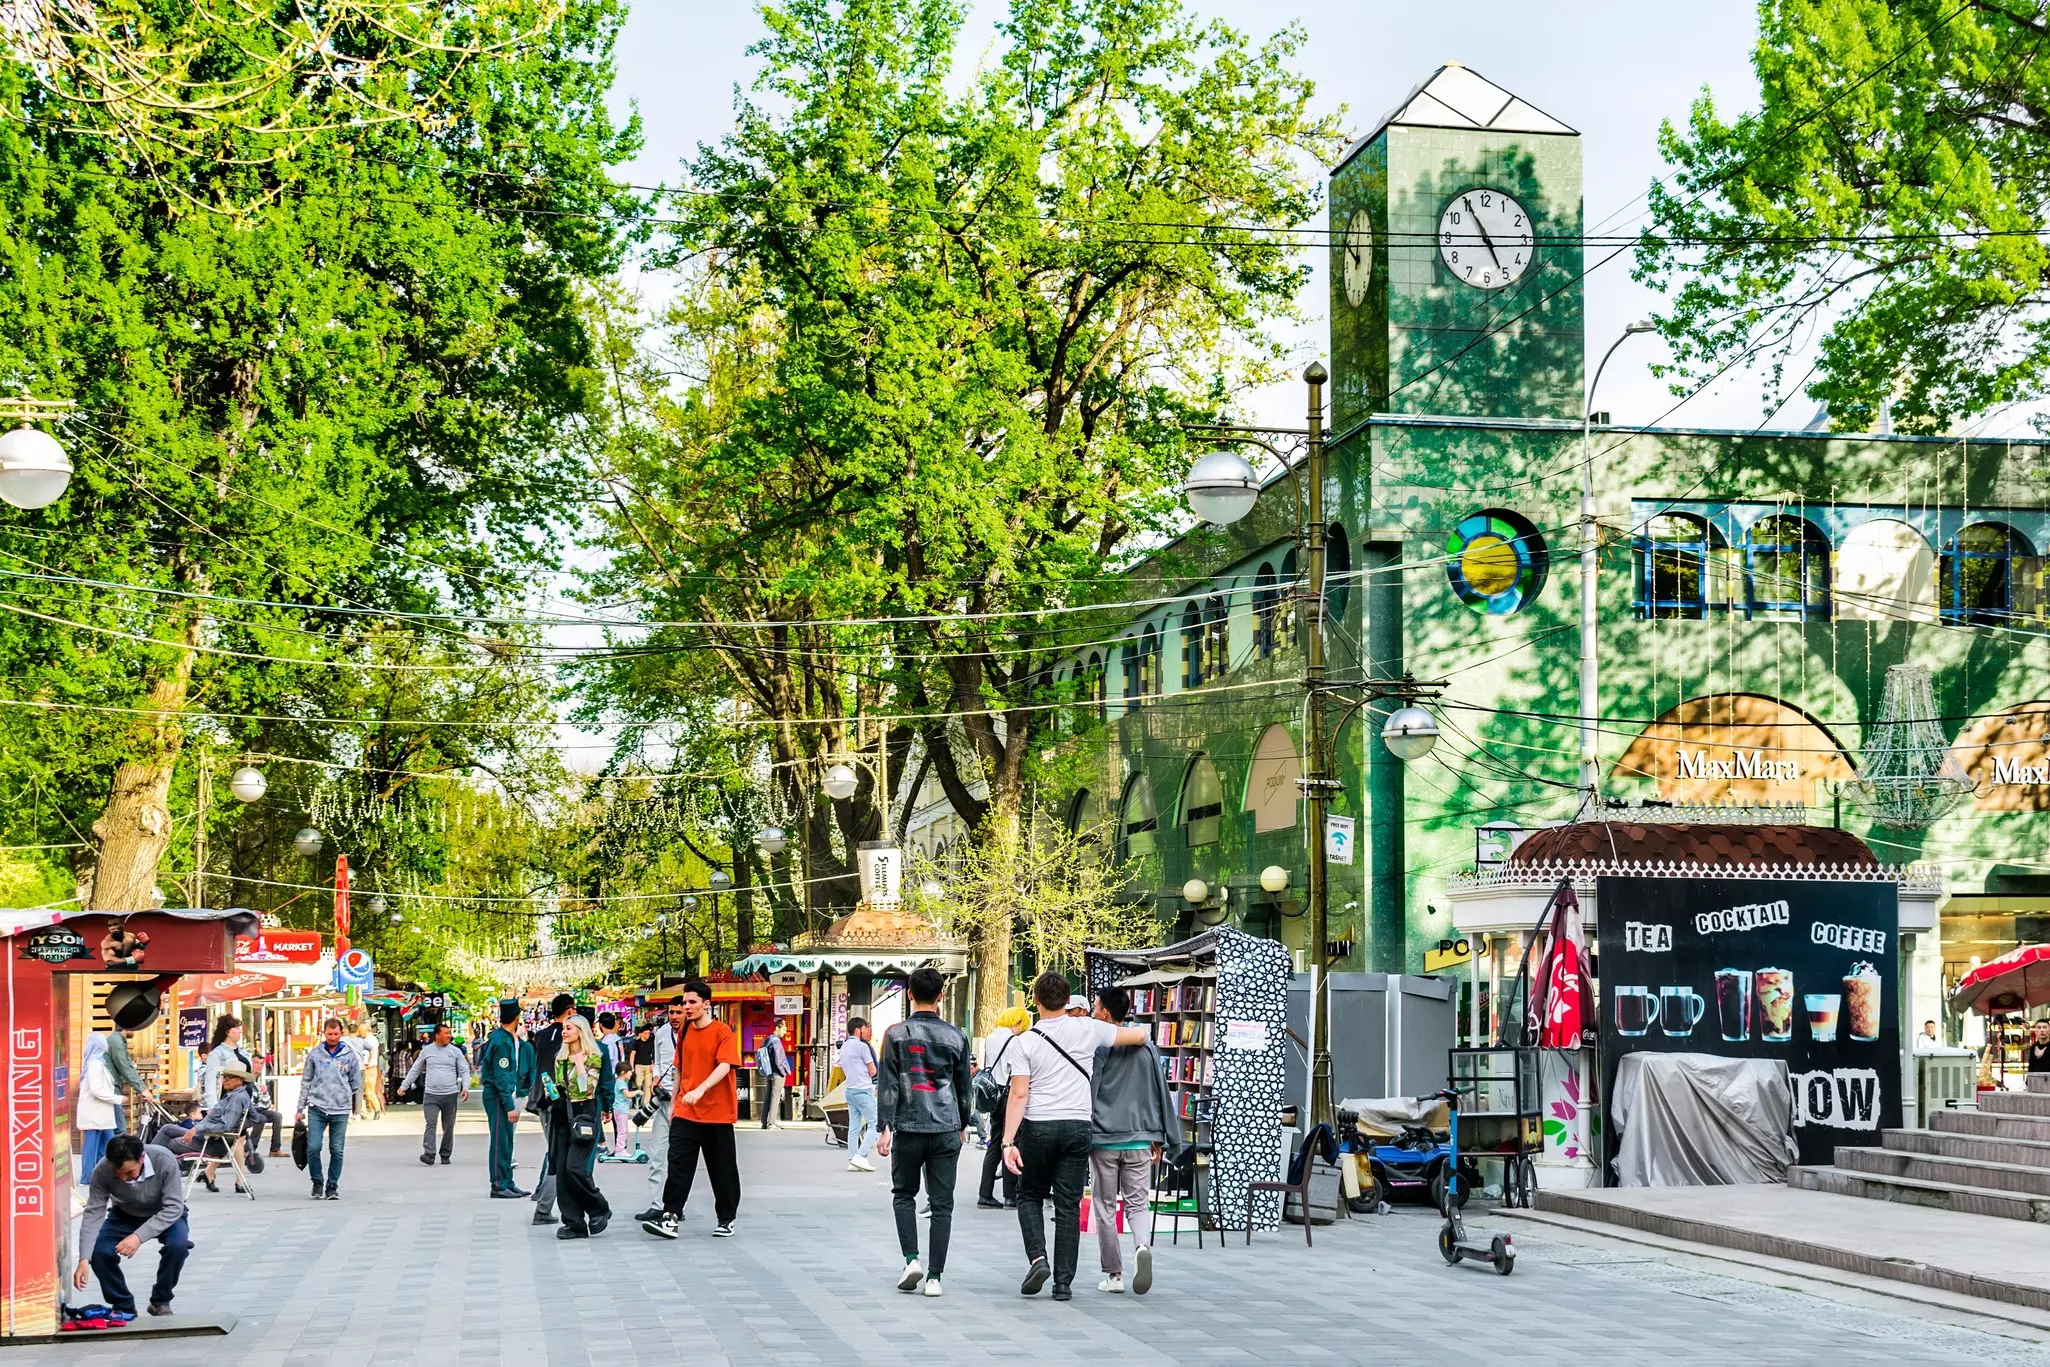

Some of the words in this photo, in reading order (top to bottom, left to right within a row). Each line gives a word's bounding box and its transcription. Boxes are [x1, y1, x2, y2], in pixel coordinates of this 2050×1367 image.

[1480, 194, 1491, 207] 12
[1501, 200, 1505, 213] 1
[1450, 212, 1460, 225] 10
[1514, 214, 1521, 227] 2
[1444, 231, 1451, 244] 9
[1521, 233, 1528, 246] 3
[1451, 251, 1458, 263] 8
[1514, 253, 1521, 265] 4
[1466, 266, 1473, 278] 7
[1484, 272, 1490, 284] 6
[1502, 267, 1509, 280] 5
[1675, 749, 1799, 780] MaxMara
[1699, 902, 1788, 932] COCKTAIL
[31, 934, 84, 945] TYSON
[1628, 926, 1670, 948] TEA
[1812, 924, 1883, 951] COFFEE
[273, 942, 314, 951] MARKET
[838, 992, 847, 1024] DOG
[12, 1027, 44, 1216] BOXING
